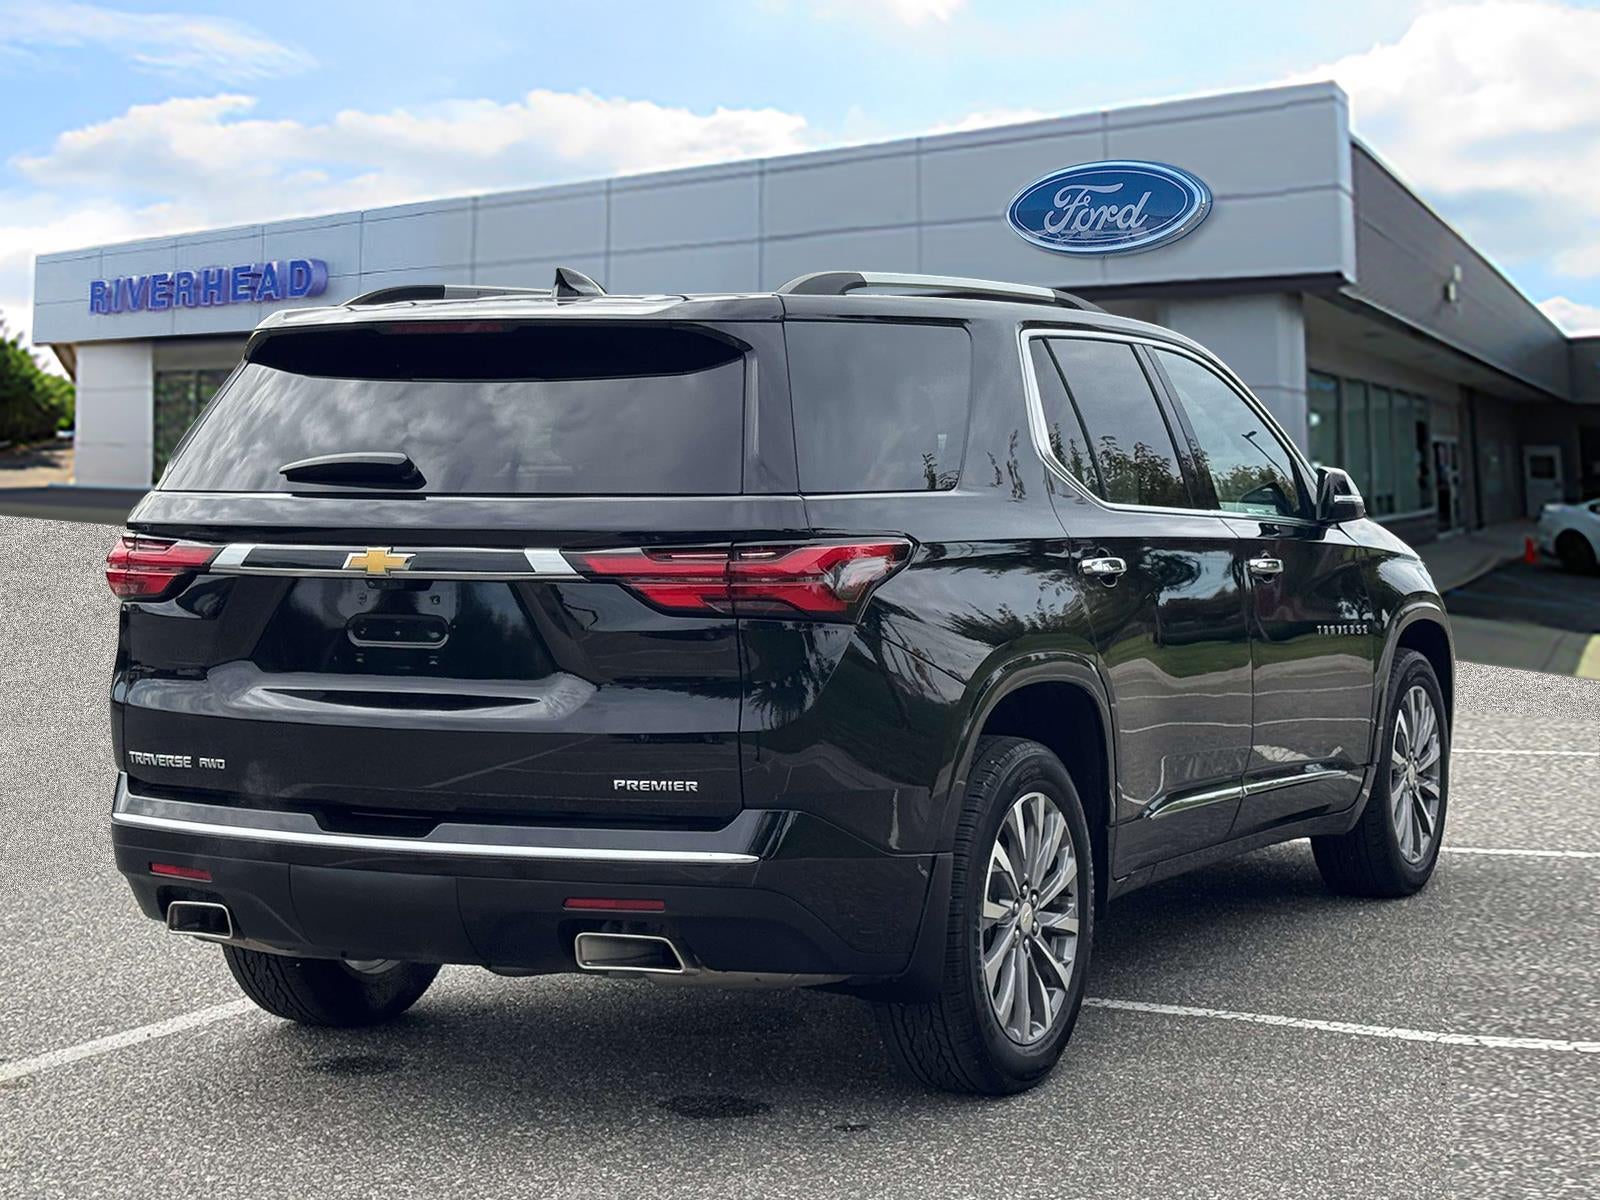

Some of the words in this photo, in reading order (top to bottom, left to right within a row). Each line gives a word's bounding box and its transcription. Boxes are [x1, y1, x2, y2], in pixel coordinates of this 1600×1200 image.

[1044, 183, 1151, 234] Ford
[89, 259, 324, 315] RIVERHEAD
[128, 750, 192, 768] TRAVERSE
[199, 757, 226, 770] AWD
[613, 779, 698, 792] PREMIER
